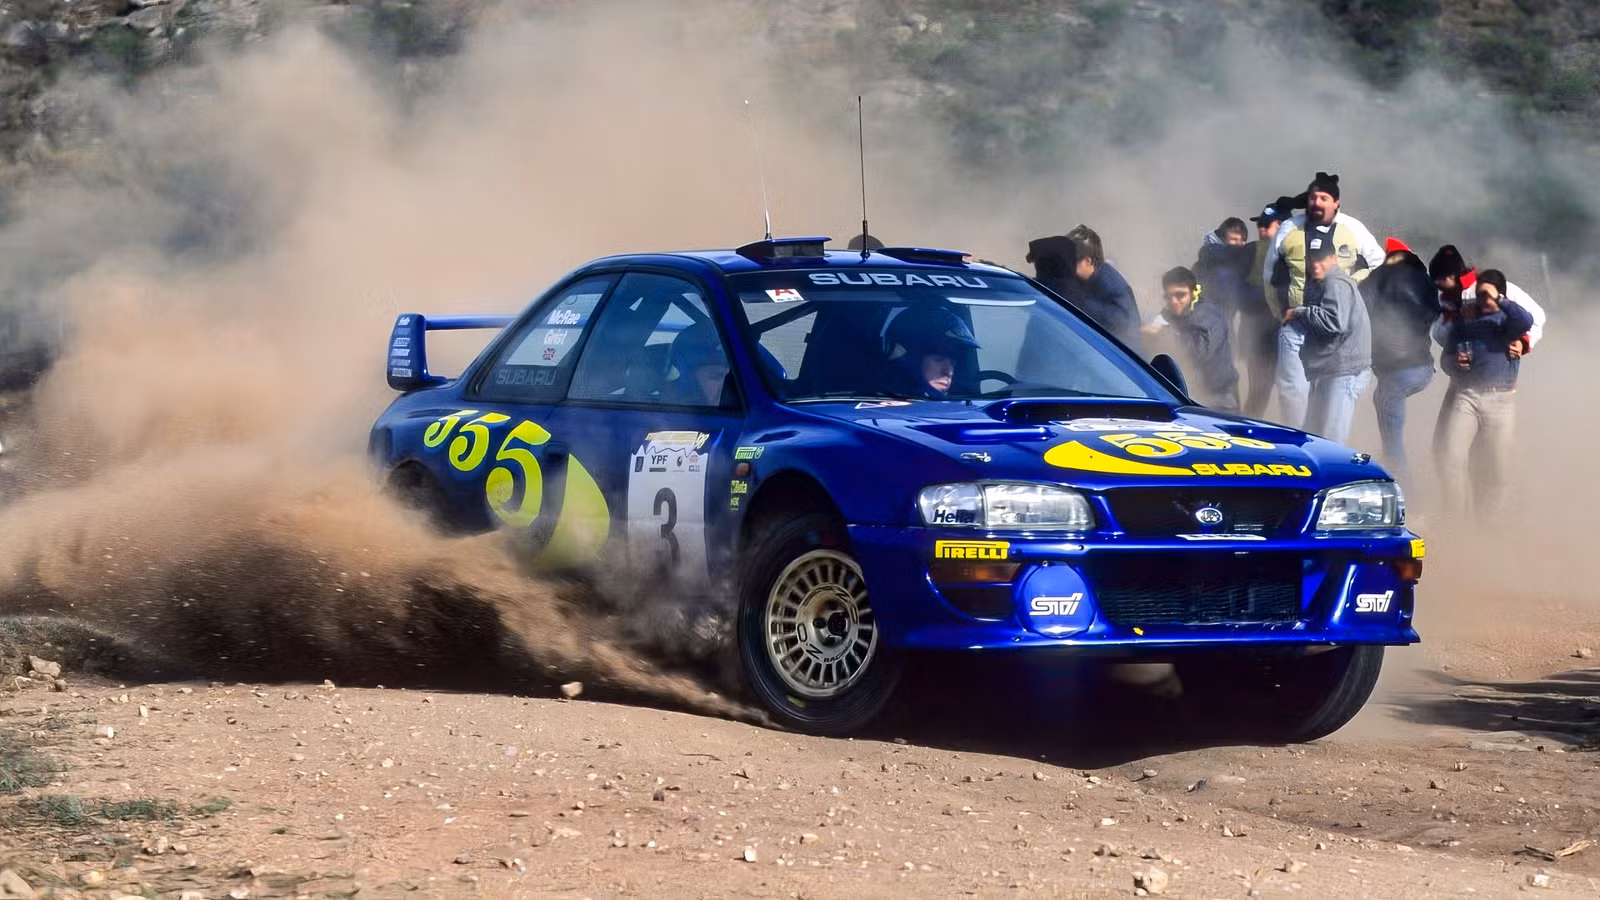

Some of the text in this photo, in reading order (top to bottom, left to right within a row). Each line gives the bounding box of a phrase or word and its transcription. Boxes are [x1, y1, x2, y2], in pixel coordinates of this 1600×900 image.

[809, 273, 988, 289] SUBARU
[547, 310, 581, 325] McRae
[496, 369, 556, 386] SUBARU
[651, 455, 668, 465] YPF
[424, 410, 552, 528] 555
[1192, 462, 1312, 477] SUBARU
[933, 509, 976, 524] Hella
[653, 488, 680, 567] 3
[935, 540, 1010, 560] PIRELLI
